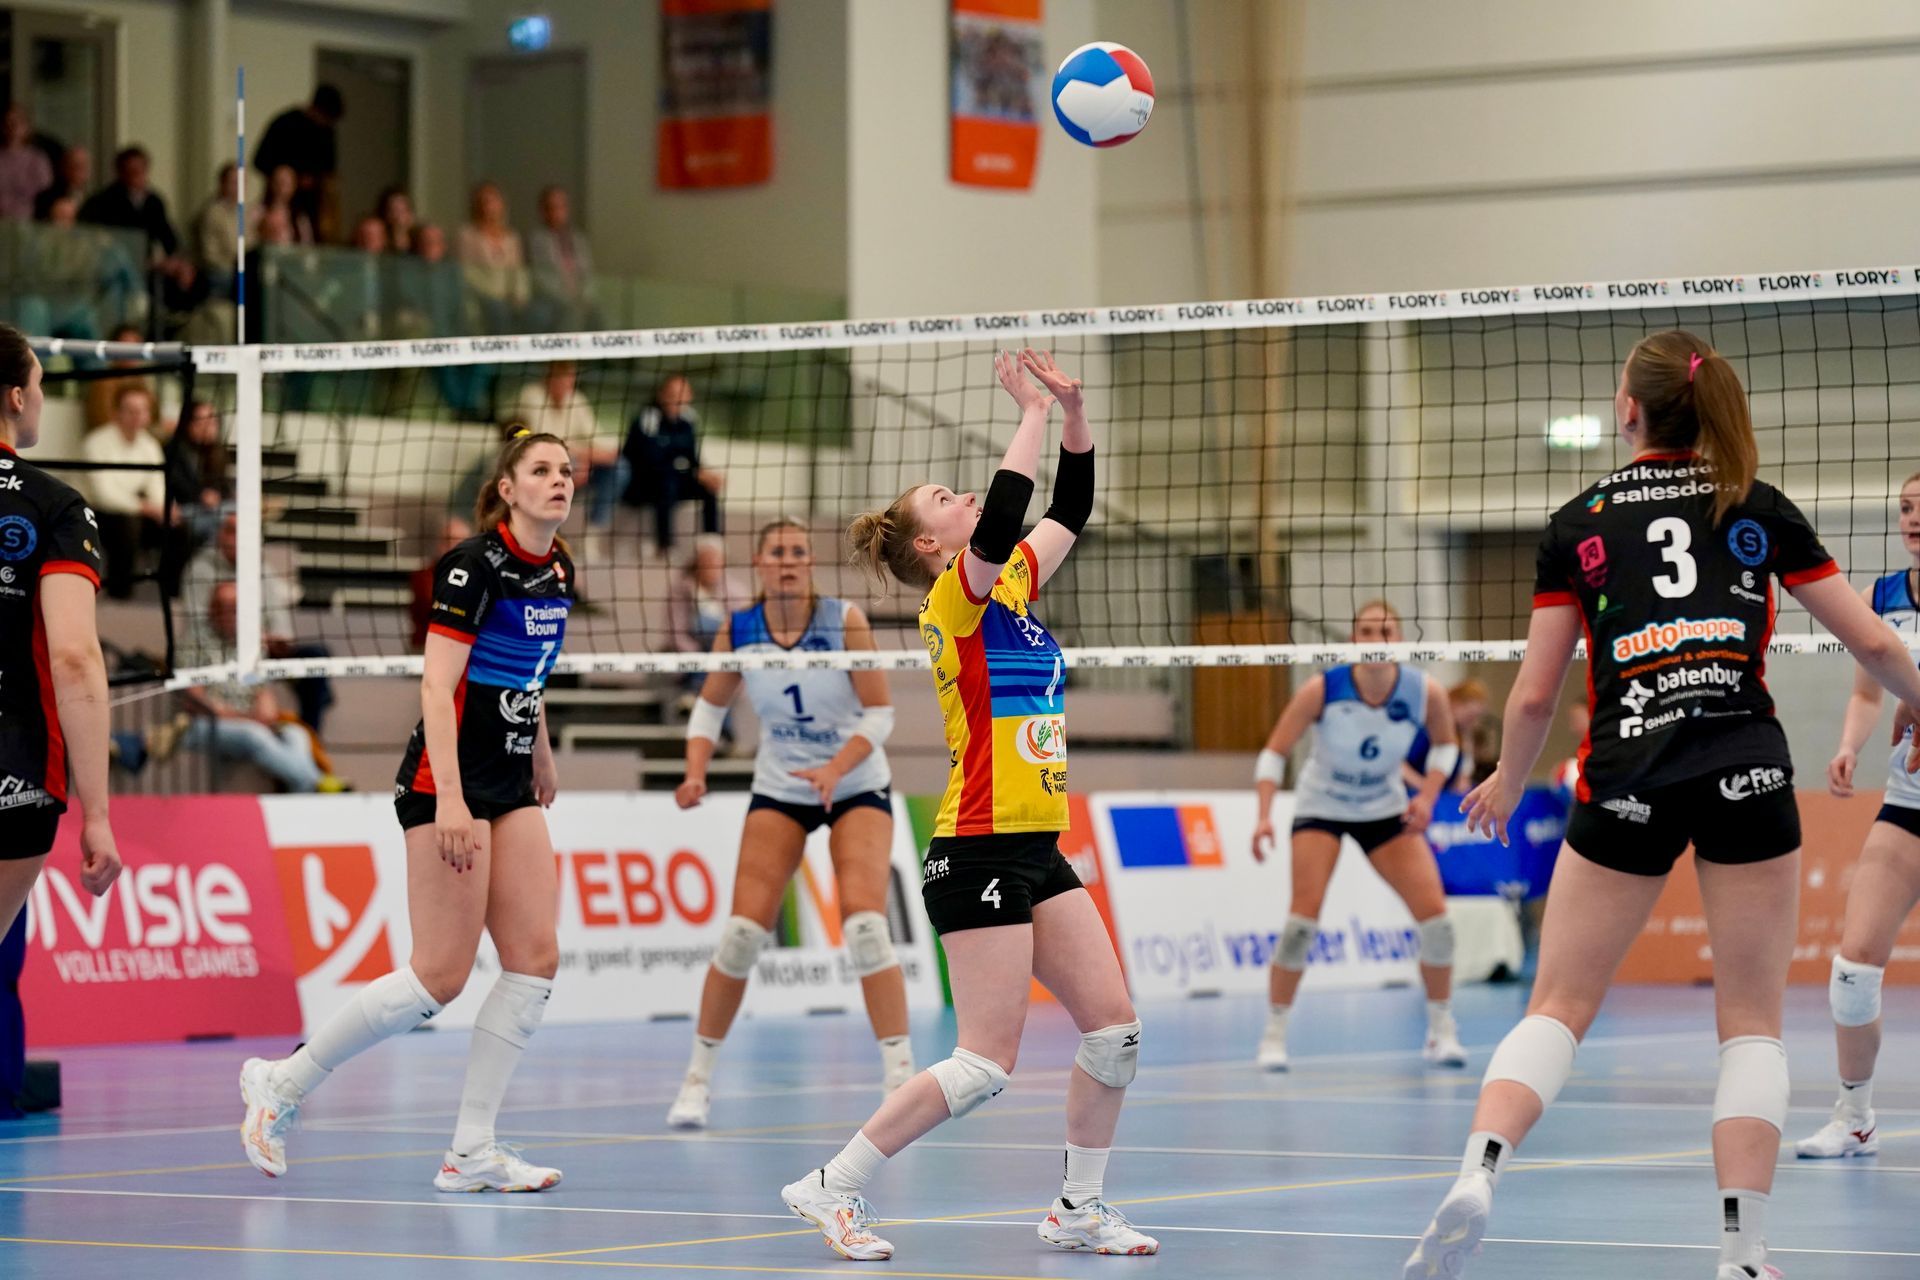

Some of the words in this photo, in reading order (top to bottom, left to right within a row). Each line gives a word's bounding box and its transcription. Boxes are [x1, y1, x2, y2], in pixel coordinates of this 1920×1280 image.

[1598, 465, 1715, 489] strikwerd
[1612, 479, 1738, 504] salesdo
[1645, 516, 1698, 598] 3
[524, 605, 568, 621] Draisma
[525, 621, 558, 637] Bouw
[1614, 618, 1746, 661] autohoppe
[1817, 642, 1849, 653] INTR
[1656, 662, 1743, 693] batenbu
[782, 684, 815, 722] 1
[1359, 734, 1380, 762] 6
[555, 849, 718, 928] EBO
[981, 878, 1002, 909] 4
[53, 948, 182, 983] VOLLEYBAL
